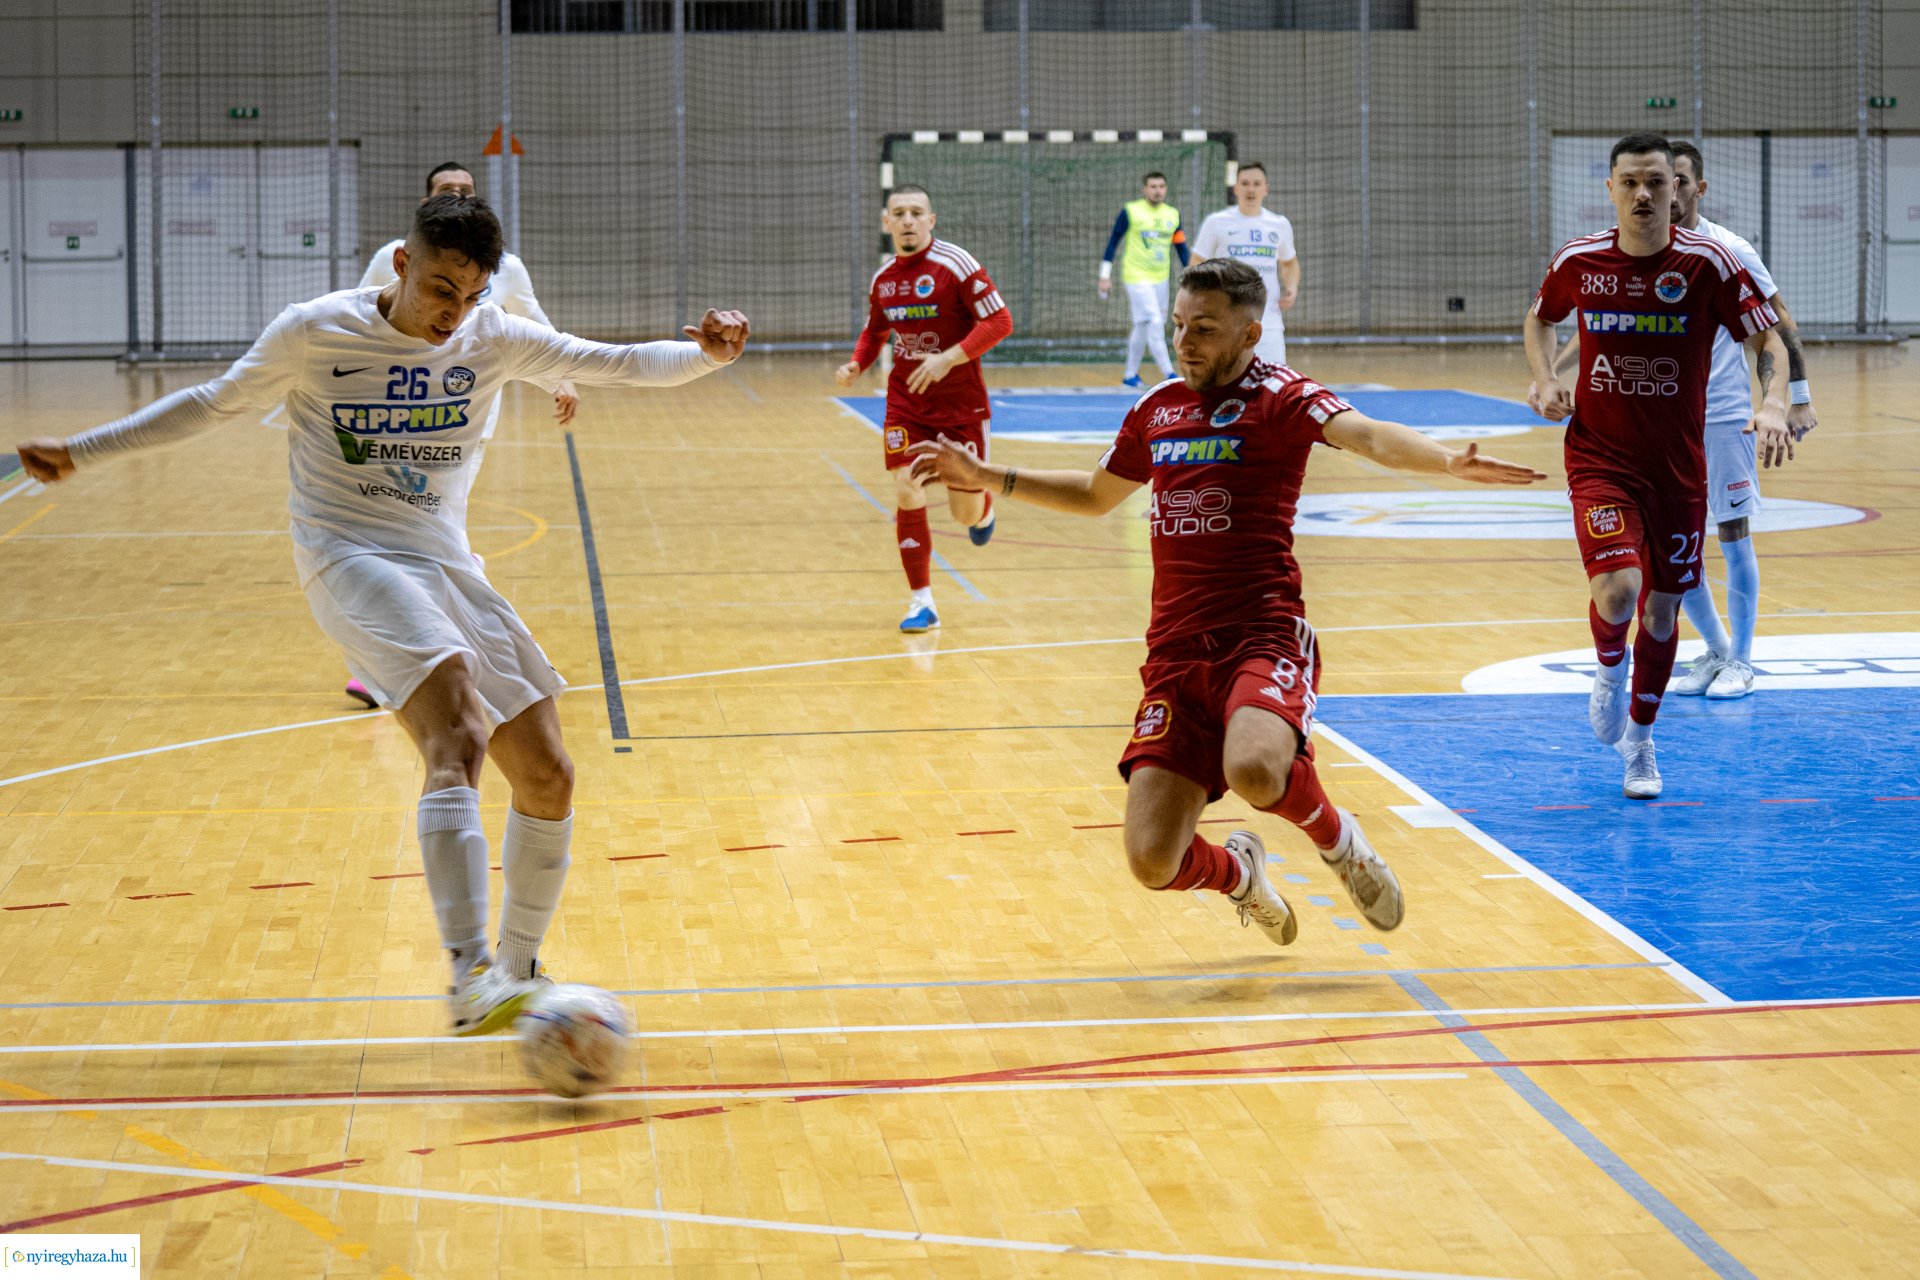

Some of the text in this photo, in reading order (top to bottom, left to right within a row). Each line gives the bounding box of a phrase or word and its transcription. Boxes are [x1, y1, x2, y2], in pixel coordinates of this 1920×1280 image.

[1581, 273, 1618, 296] 383
[386, 366, 431, 400] 26
[1590, 378, 1679, 396] STUDIO
[1150, 515, 1232, 537] TUDIO
[1600, 522, 1616, 533] FM
[1271, 658, 1298, 689] 8
